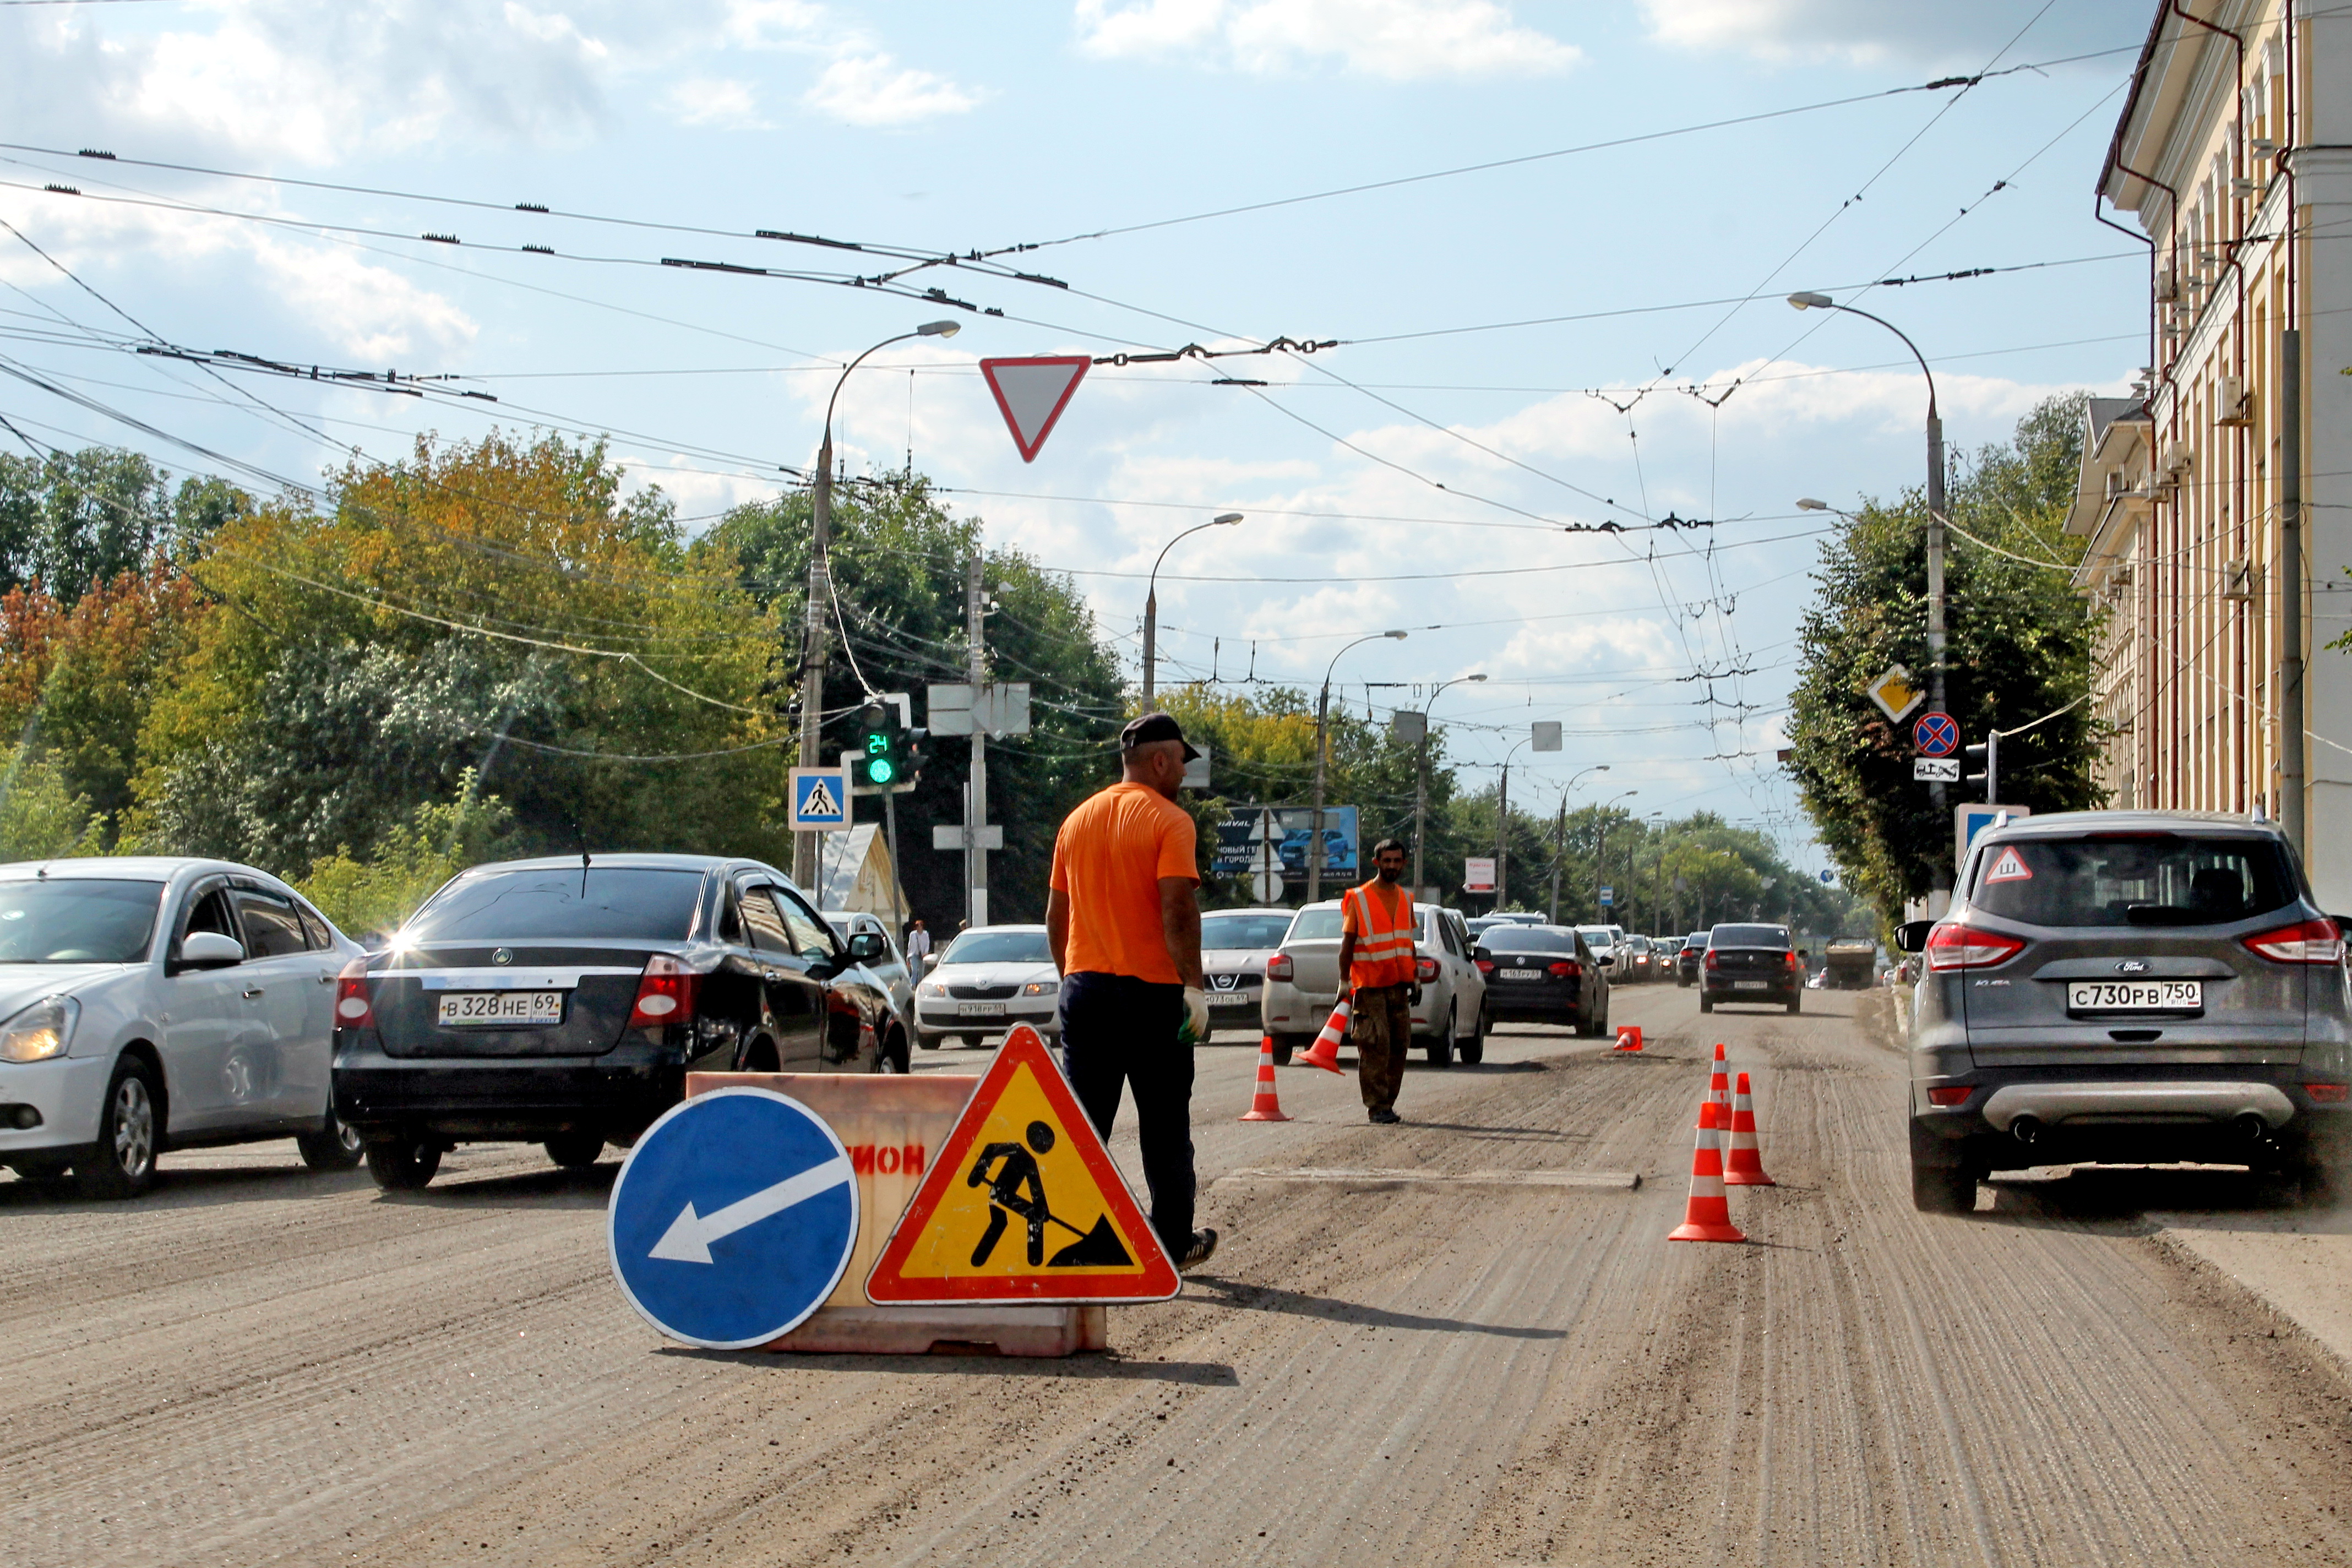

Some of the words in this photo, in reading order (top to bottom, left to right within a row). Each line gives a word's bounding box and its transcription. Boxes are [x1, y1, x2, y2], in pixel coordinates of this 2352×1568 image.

[869, 734, 888, 754] 24
[2000, 863, 2016, 875] Ш
[2123, 962, 2144, 971] Ford
[2075, 985, 2159, 1005] С730РВ
[2164, 983, 2196, 999] 750
[447, 997, 527, 1016] В328НЕ
[534, 995, 555, 1010] 69
